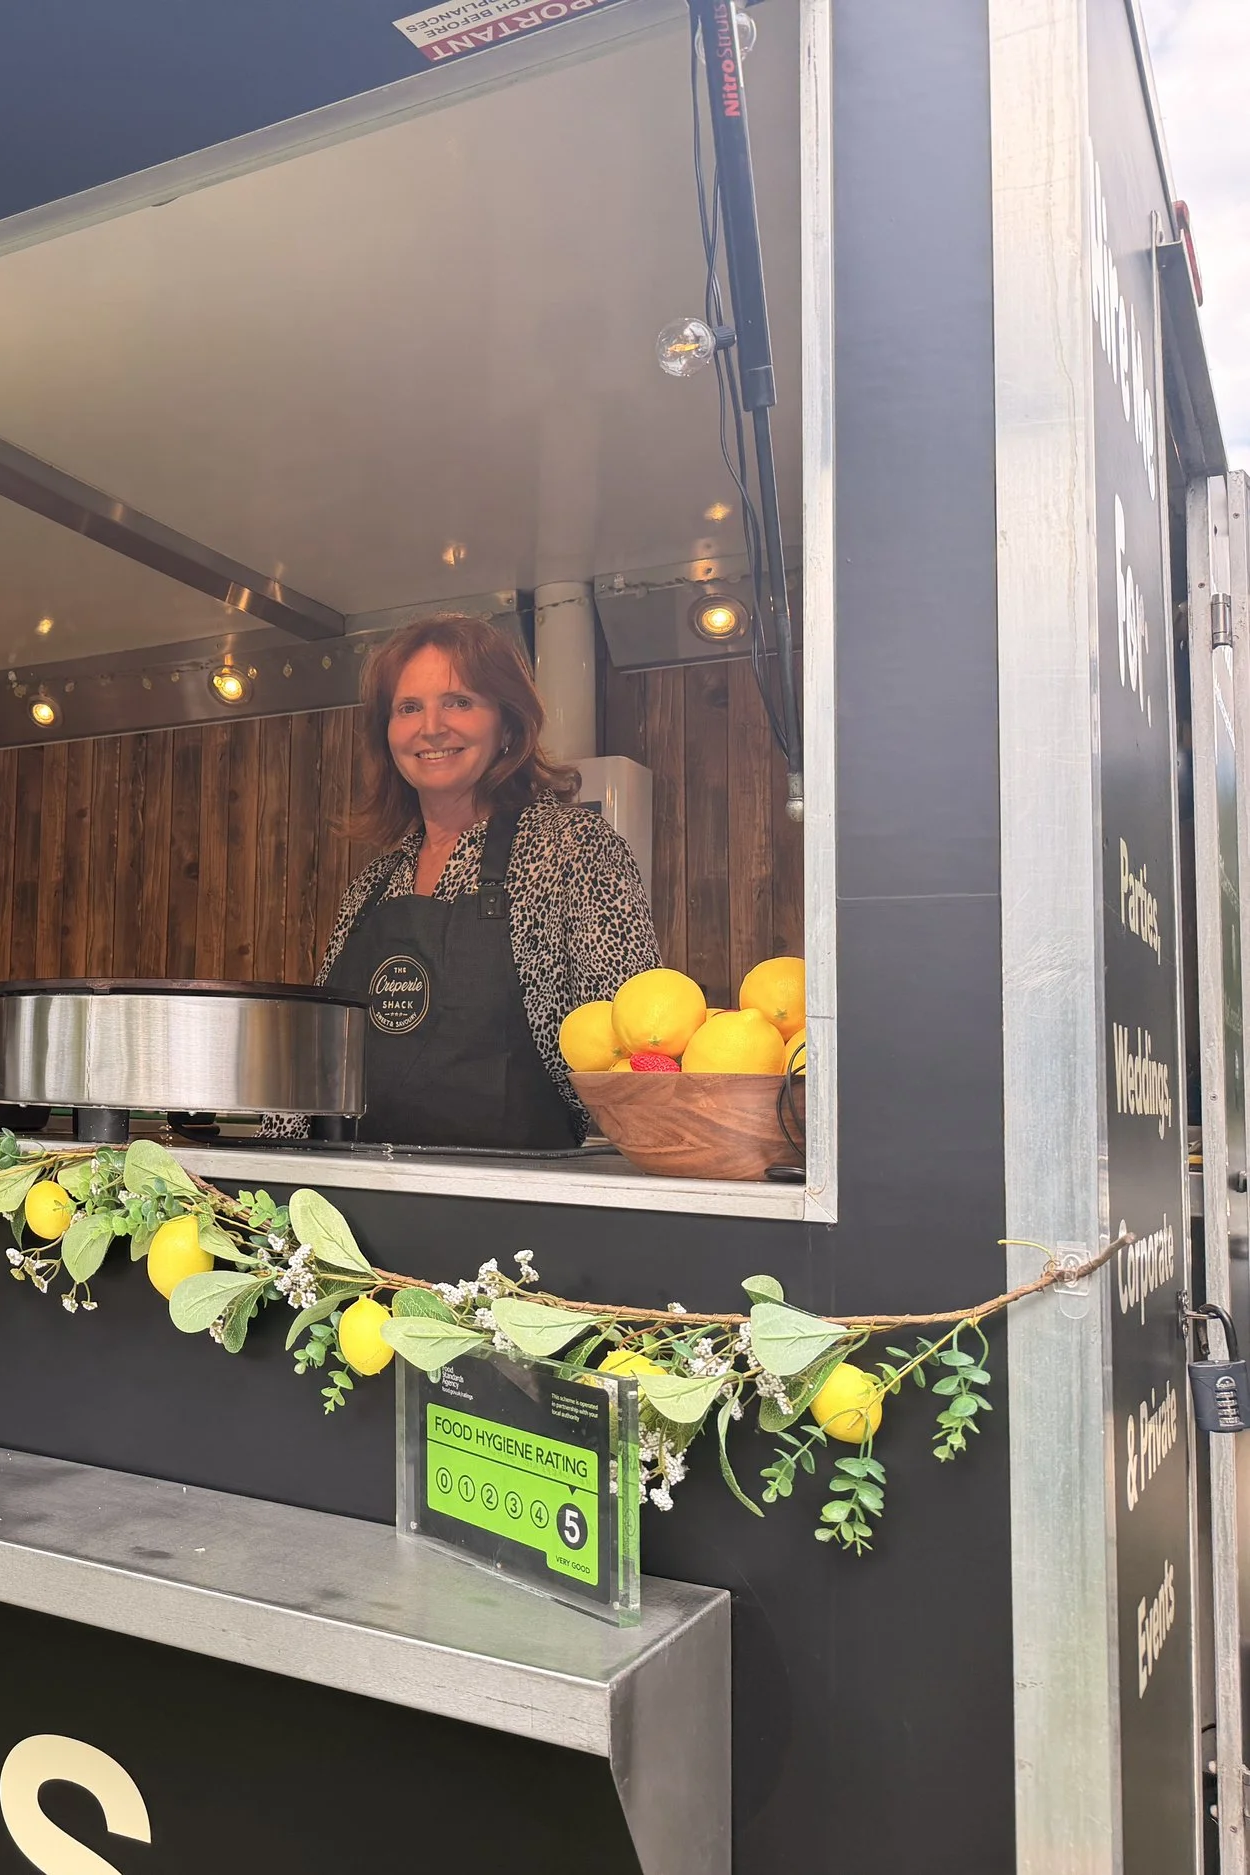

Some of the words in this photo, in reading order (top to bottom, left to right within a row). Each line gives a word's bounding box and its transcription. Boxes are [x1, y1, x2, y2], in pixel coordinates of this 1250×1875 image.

[405, 0, 495, 33] PLIANCES
[424, 8, 493, 38] BEFORE
[431, 0, 606, 61] PORTANT
[496, 0, 532, 12] TCH
[713, 3, 741, 117] NitroStruts
[1130, 303, 1156, 501] Me
[1119, 836, 1161, 965] Parties,
[393, 966, 407, 974] THE
[382, 1000, 414, 1009] SHACK
[395, 1011, 418, 1028] SAVOURY
[1112, 1022, 1172, 1140] Weddings,
[1117, 1213, 1175, 1326] Corporate
[434, 1415, 473, 1441] FOOD
[475, 1428, 533, 1461] HYGIENE
[535, 1446, 588, 1478] RATING
[1126, 1414, 1139, 1512] &
[1139, 1379, 1178, 1492] Private
[563, 1508, 581, 1544] 5
[555, 1555, 570, 1567] VERY
[571, 1562, 591, 1574] GOOD
[1137, 1559, 1175, 1700] Events
